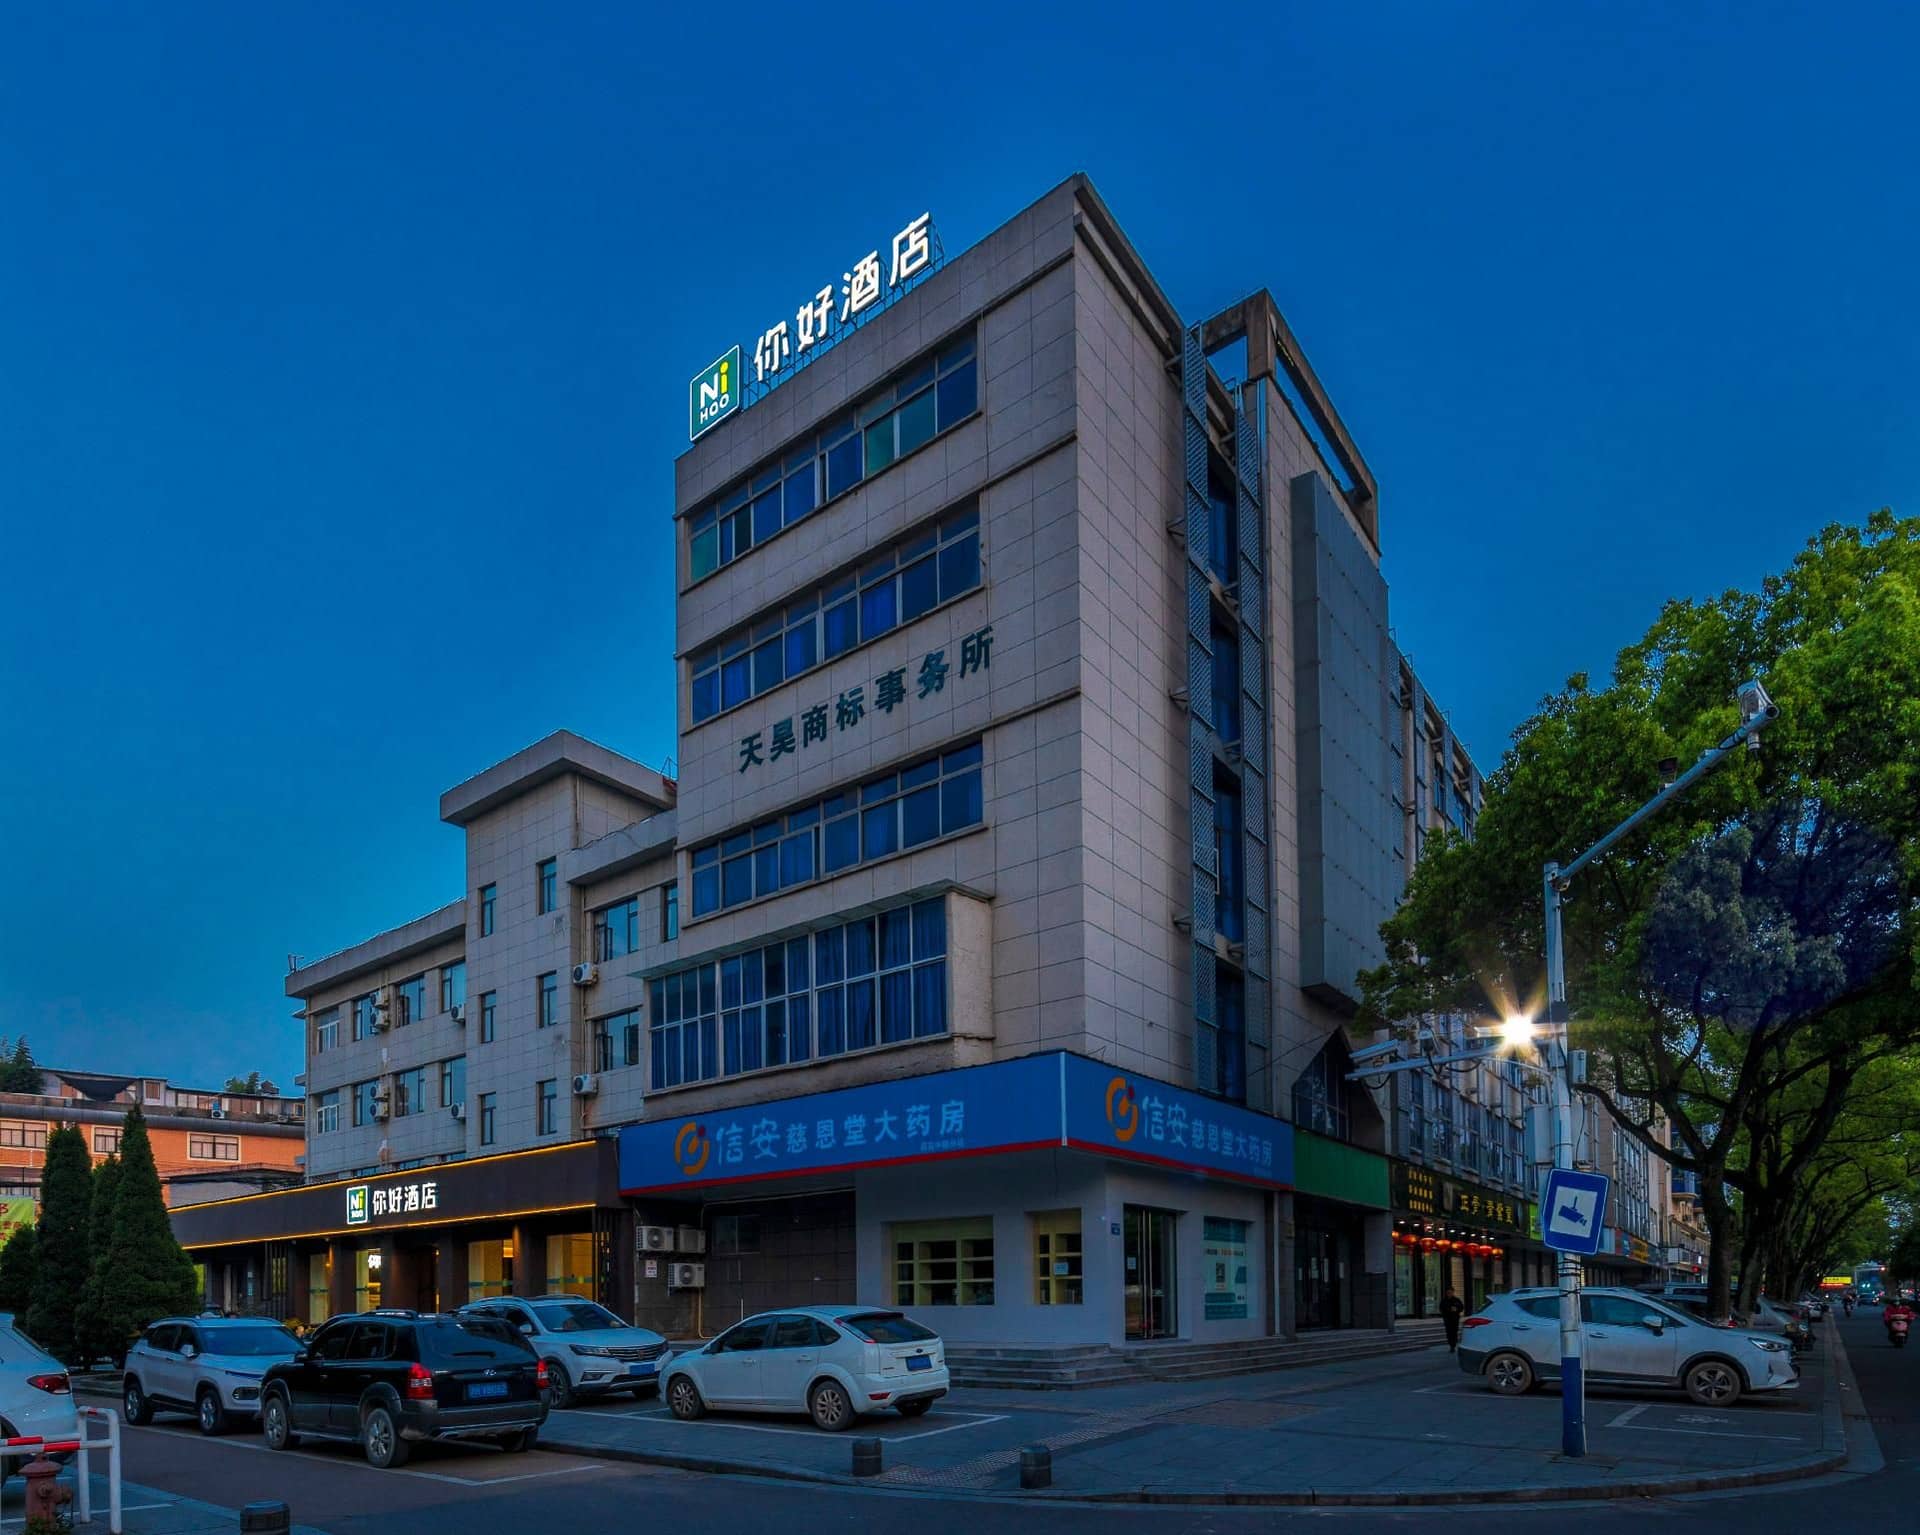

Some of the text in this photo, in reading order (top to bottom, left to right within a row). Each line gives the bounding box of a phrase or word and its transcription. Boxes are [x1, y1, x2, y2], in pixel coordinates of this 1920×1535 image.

[753, 211, 931, 382] 你好酒店
[699, 361, 729, 410] Ni
[699, 394, 730, 424] HOO
[739, 626, 994, 774] 天昊商标事务所
[716, 1100, 965, 1166] 信安慈恩堂大药房
[1142, 1095, 1273, 1167] 信安慈恩堂大药房
[350, 1190, 364, 1210] Ni
[372, 1182, 437, 1216] 你好酒店
